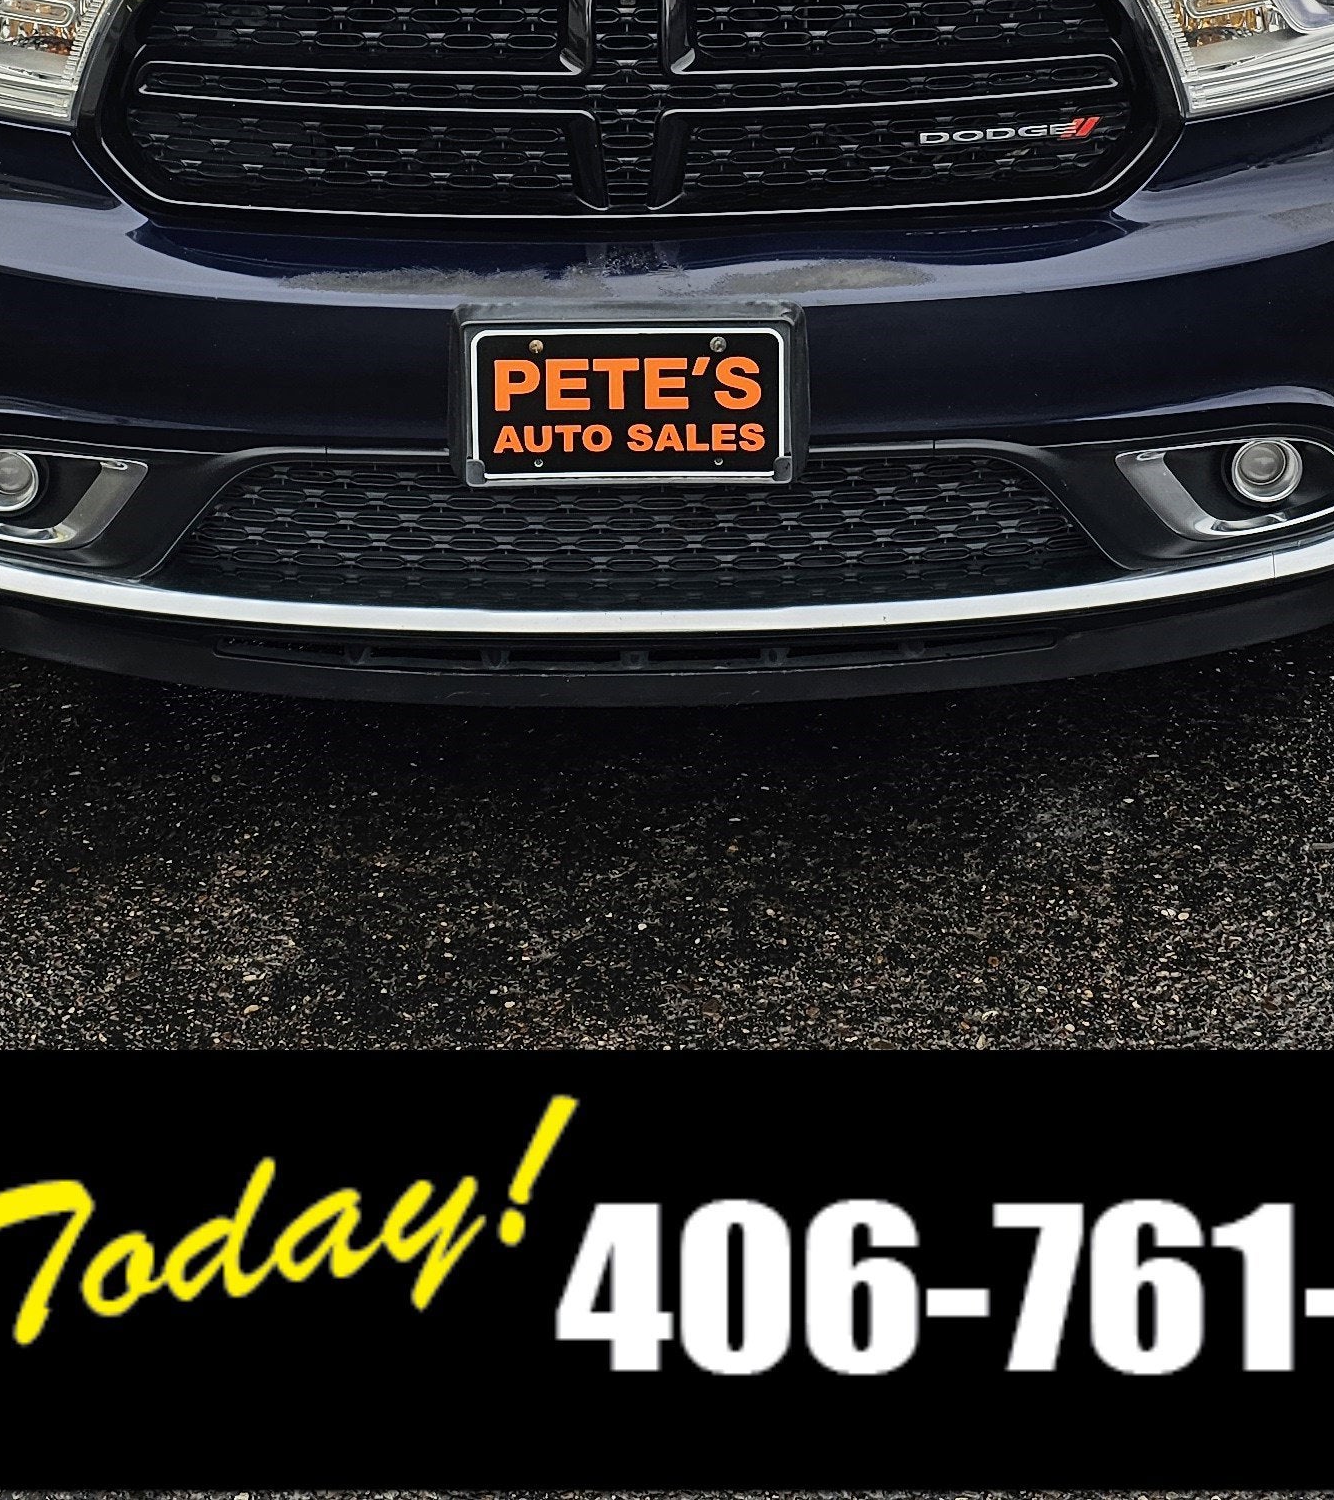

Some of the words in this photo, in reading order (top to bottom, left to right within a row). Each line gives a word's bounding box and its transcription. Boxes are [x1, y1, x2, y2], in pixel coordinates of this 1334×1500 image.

[919, 121, 1078, 145] DODGE
[493, 356, 763, 412] PETE'S
[493, 423, 613, 454] AUTO
[626, 422, 766, 453] SALES
